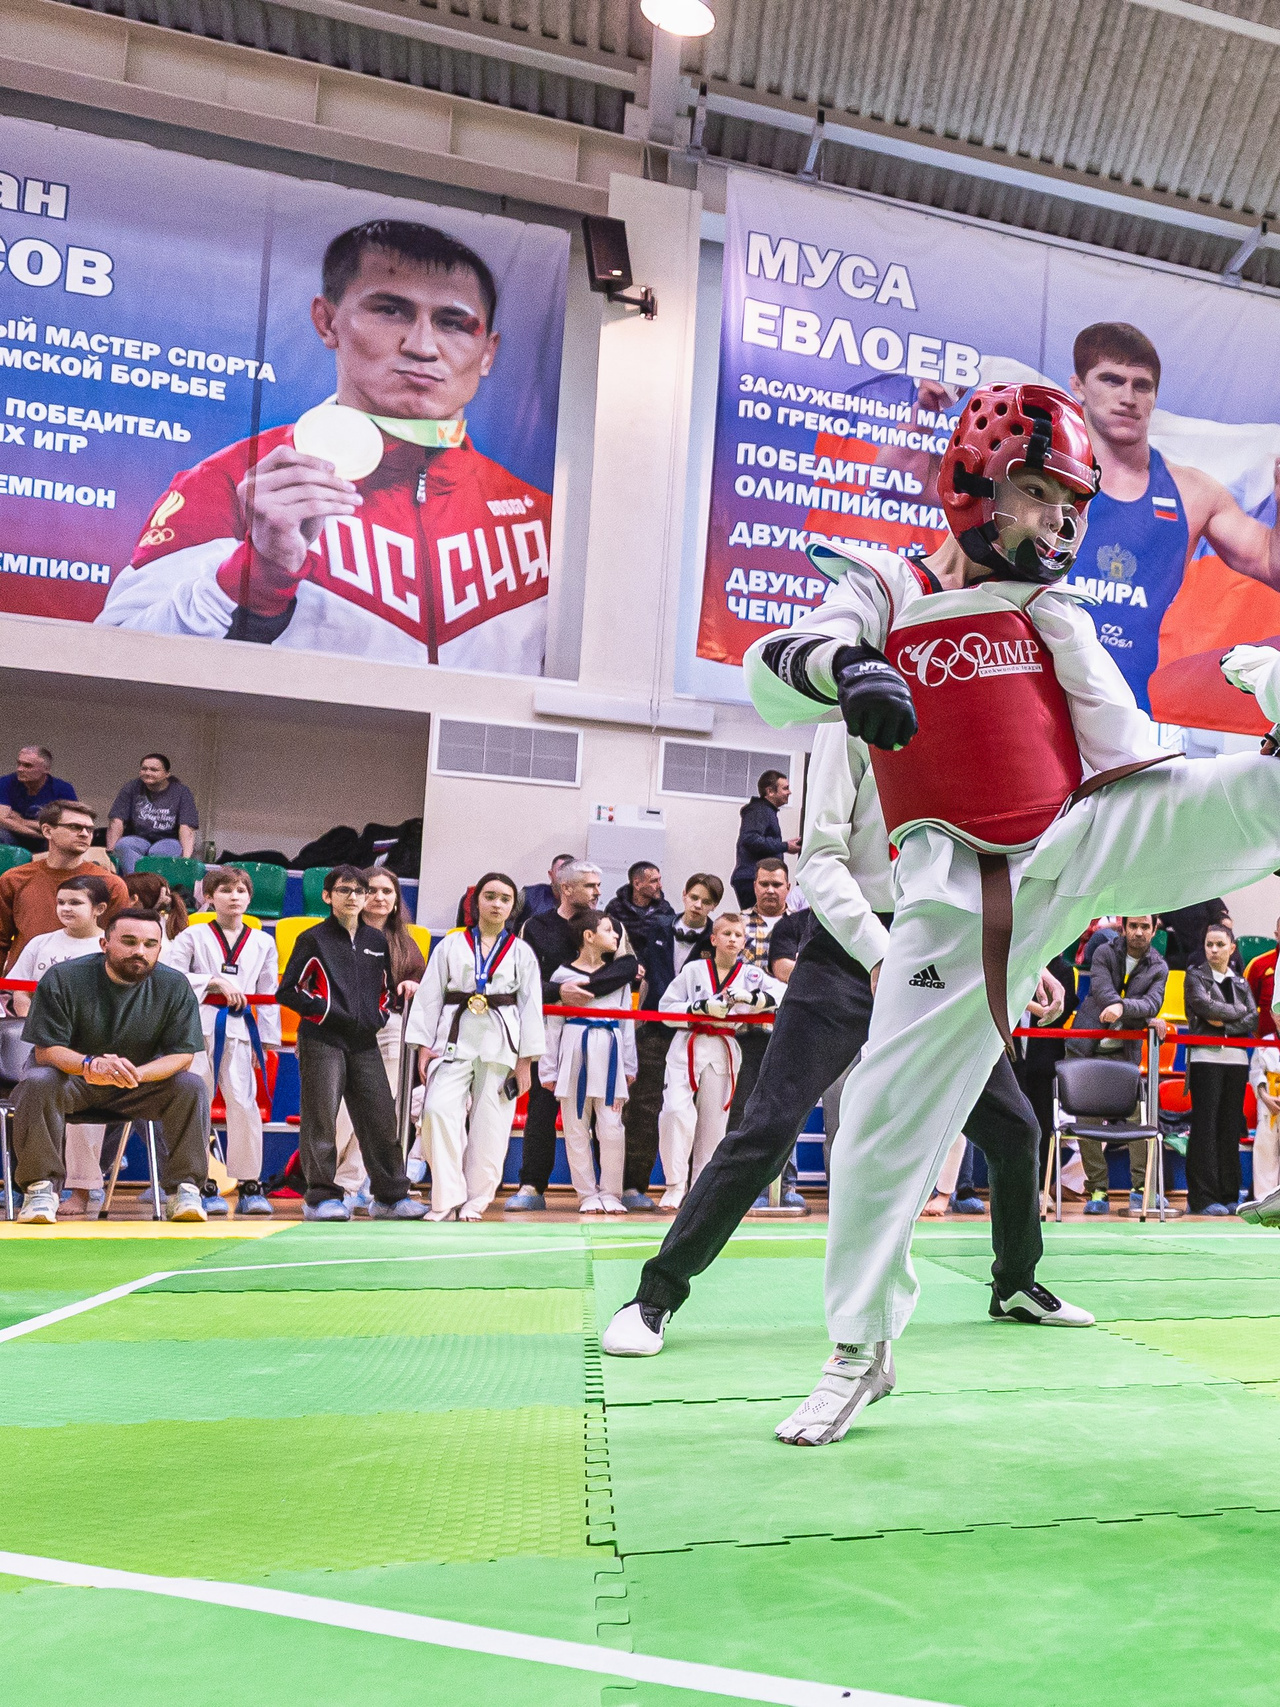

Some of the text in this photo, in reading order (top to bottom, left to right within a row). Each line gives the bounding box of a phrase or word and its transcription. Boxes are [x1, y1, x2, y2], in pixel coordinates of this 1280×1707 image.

[0, 236, 115, 298] ОВ
[746, 230, 918, 311] МУСА
[45, 325, 162, 362] МАСТЕР
[167, 346, 277, 383] СПОРТА
[742, 297, 981, 388] ЕВЛОЕВ
[110, 364, 227, 400] БОРЬБЕ
[738, 373, 911, 424] ЗАСЛУЖЕННЫЙ
[5, 397, 192, 443] ПОБЕДИТЕЛЬ
[738, 399, 772, 421] ПО
[0, 423, 88, 454] Х ИГР
[736, 442, 923, 496] ПОБЕДИТЕЛЬ
[0, 552, 111, 585] МПИОН
[308, 515, 549, 625] ОССИЯ
[1074, 576, 1148, 608] МИРА
[908, 978, 946, 989] adidas
